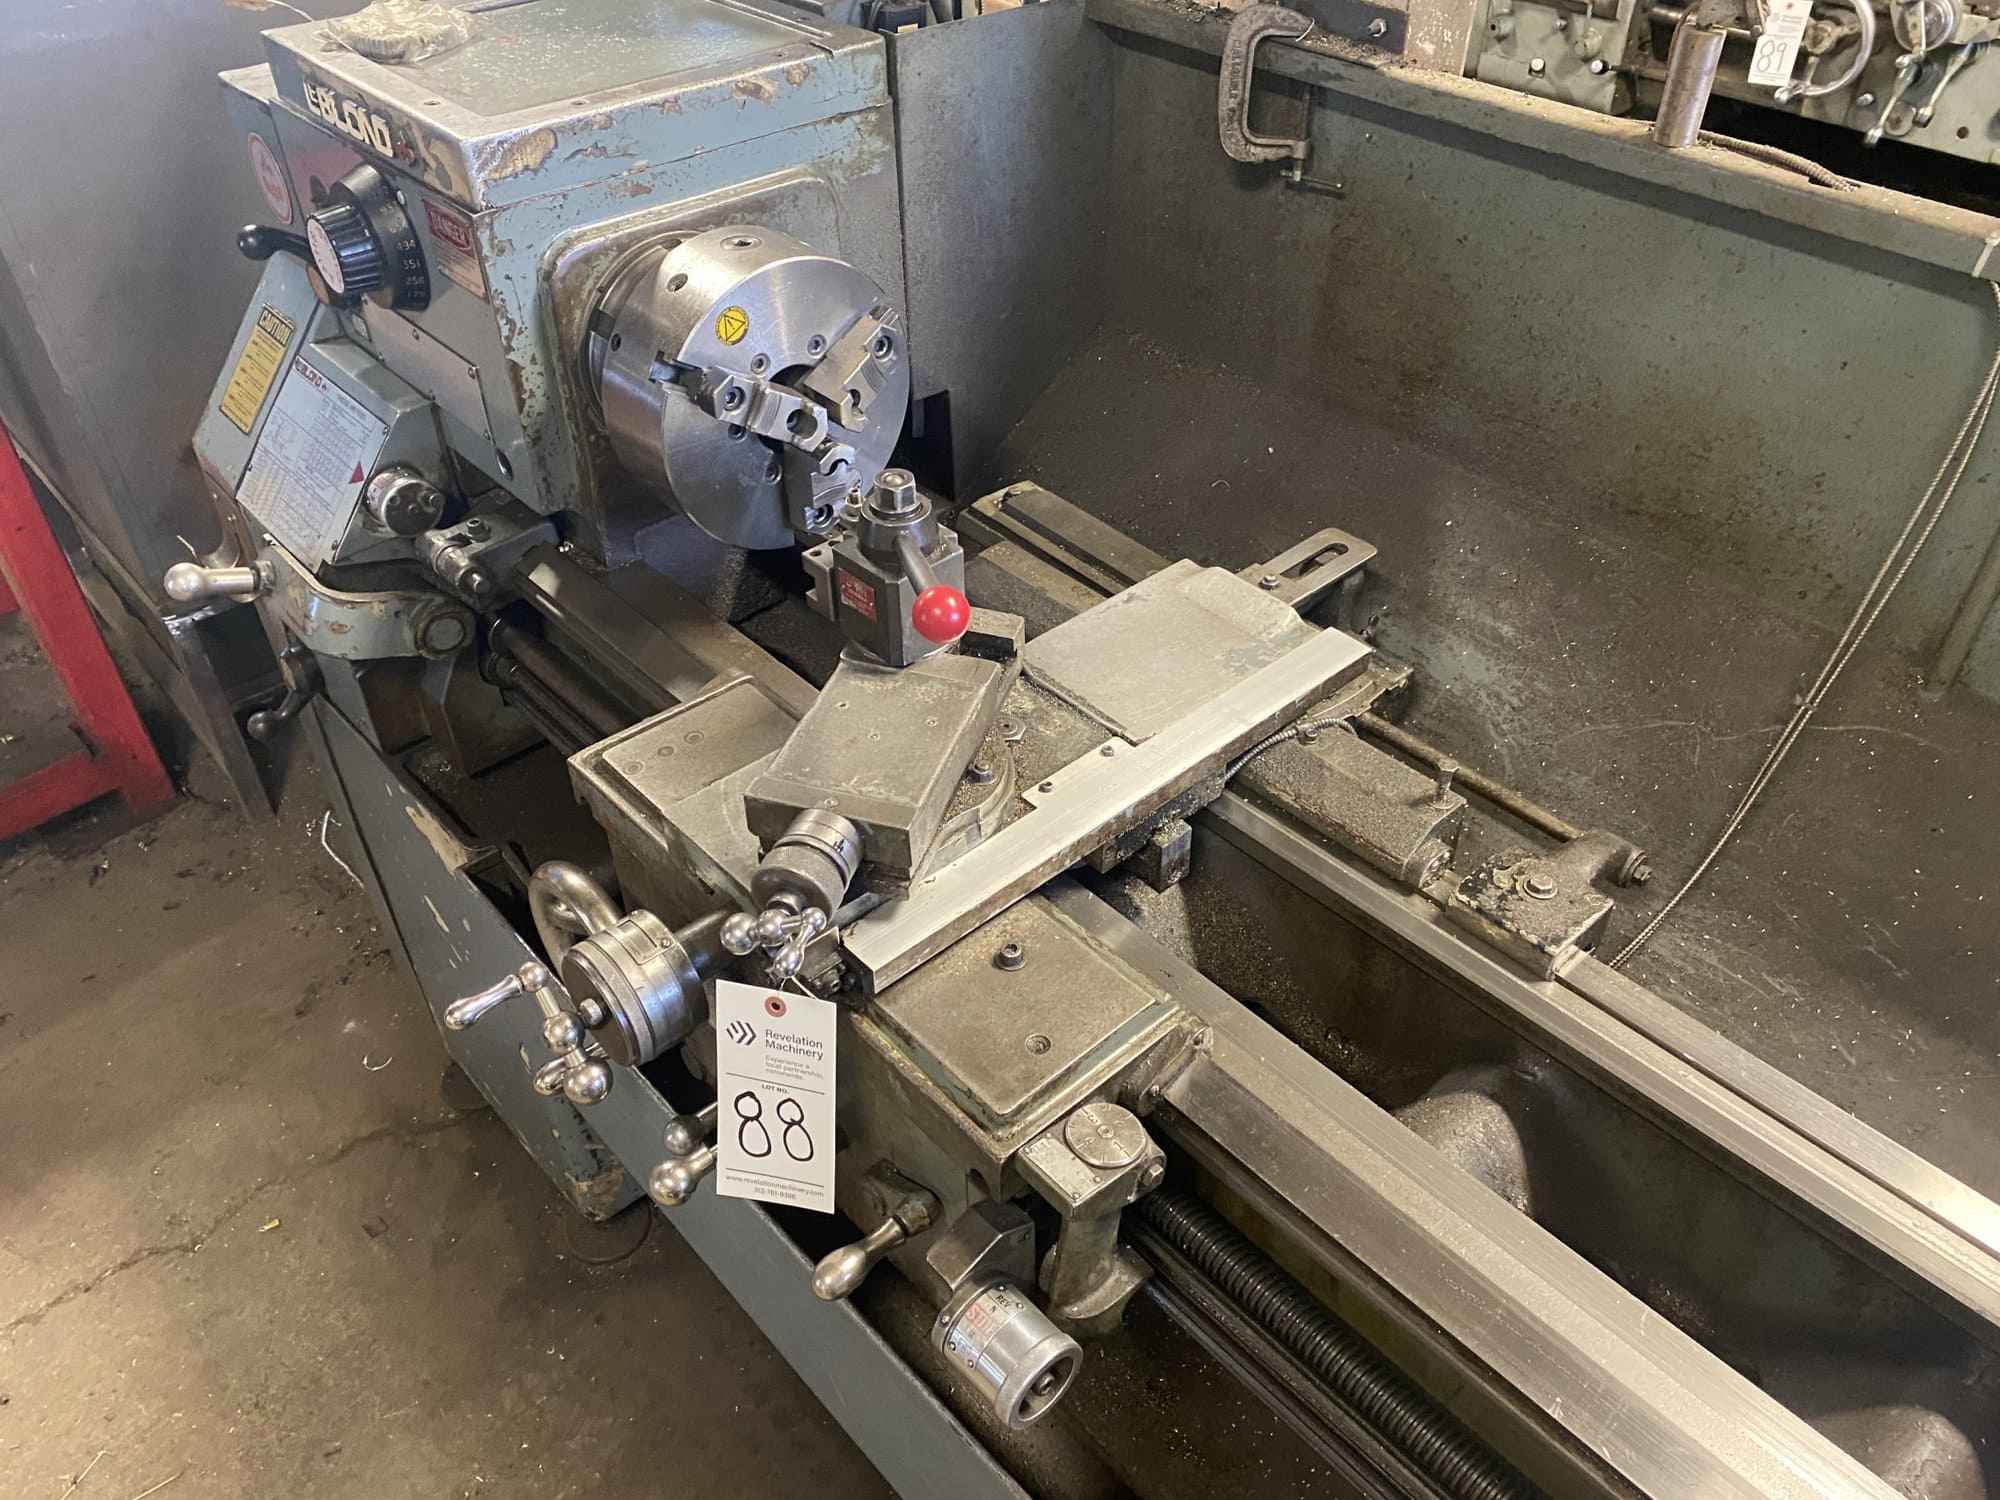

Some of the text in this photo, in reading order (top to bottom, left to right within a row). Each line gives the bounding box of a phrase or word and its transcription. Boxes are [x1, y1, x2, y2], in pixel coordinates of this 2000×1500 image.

[1757, 40, 1787, 73] 89
[428, 209, 468, 247] DANGER
[258, 308, 292, 346] CAUTION
[765, 1028, 823, 1049] Revelation
[765, 1039, 824, 1061] Machinery
[761, 1083, 775, 1092] LOT
[734, 1090, 815, 1162] 88
[996, 1294, 1012, 1308] REV
